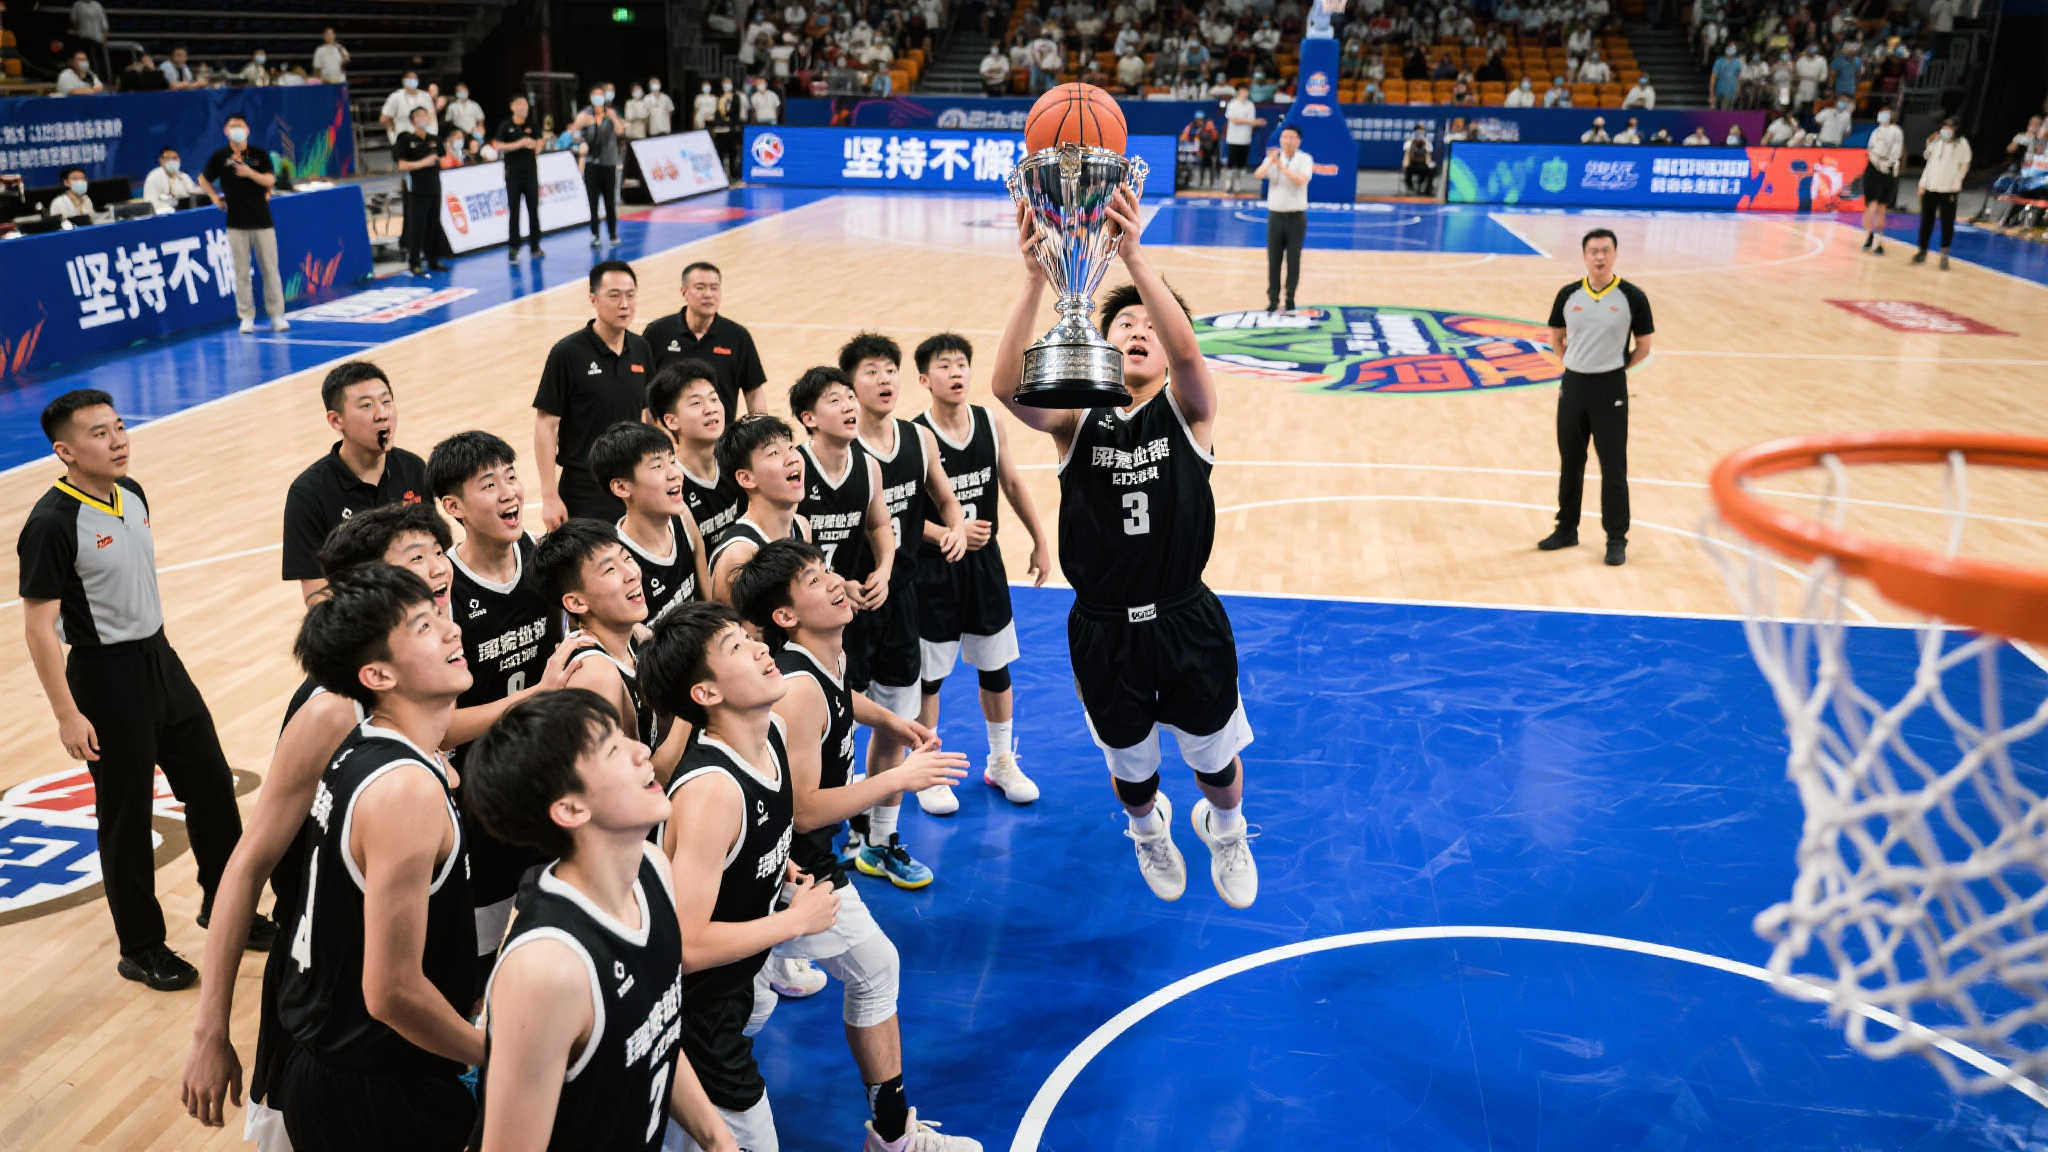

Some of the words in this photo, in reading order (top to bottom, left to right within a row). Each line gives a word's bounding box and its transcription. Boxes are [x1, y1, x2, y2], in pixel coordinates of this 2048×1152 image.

[842, 136, 1029, 181] 坚持不懈
[1122, 491, 1150, 536] 3
